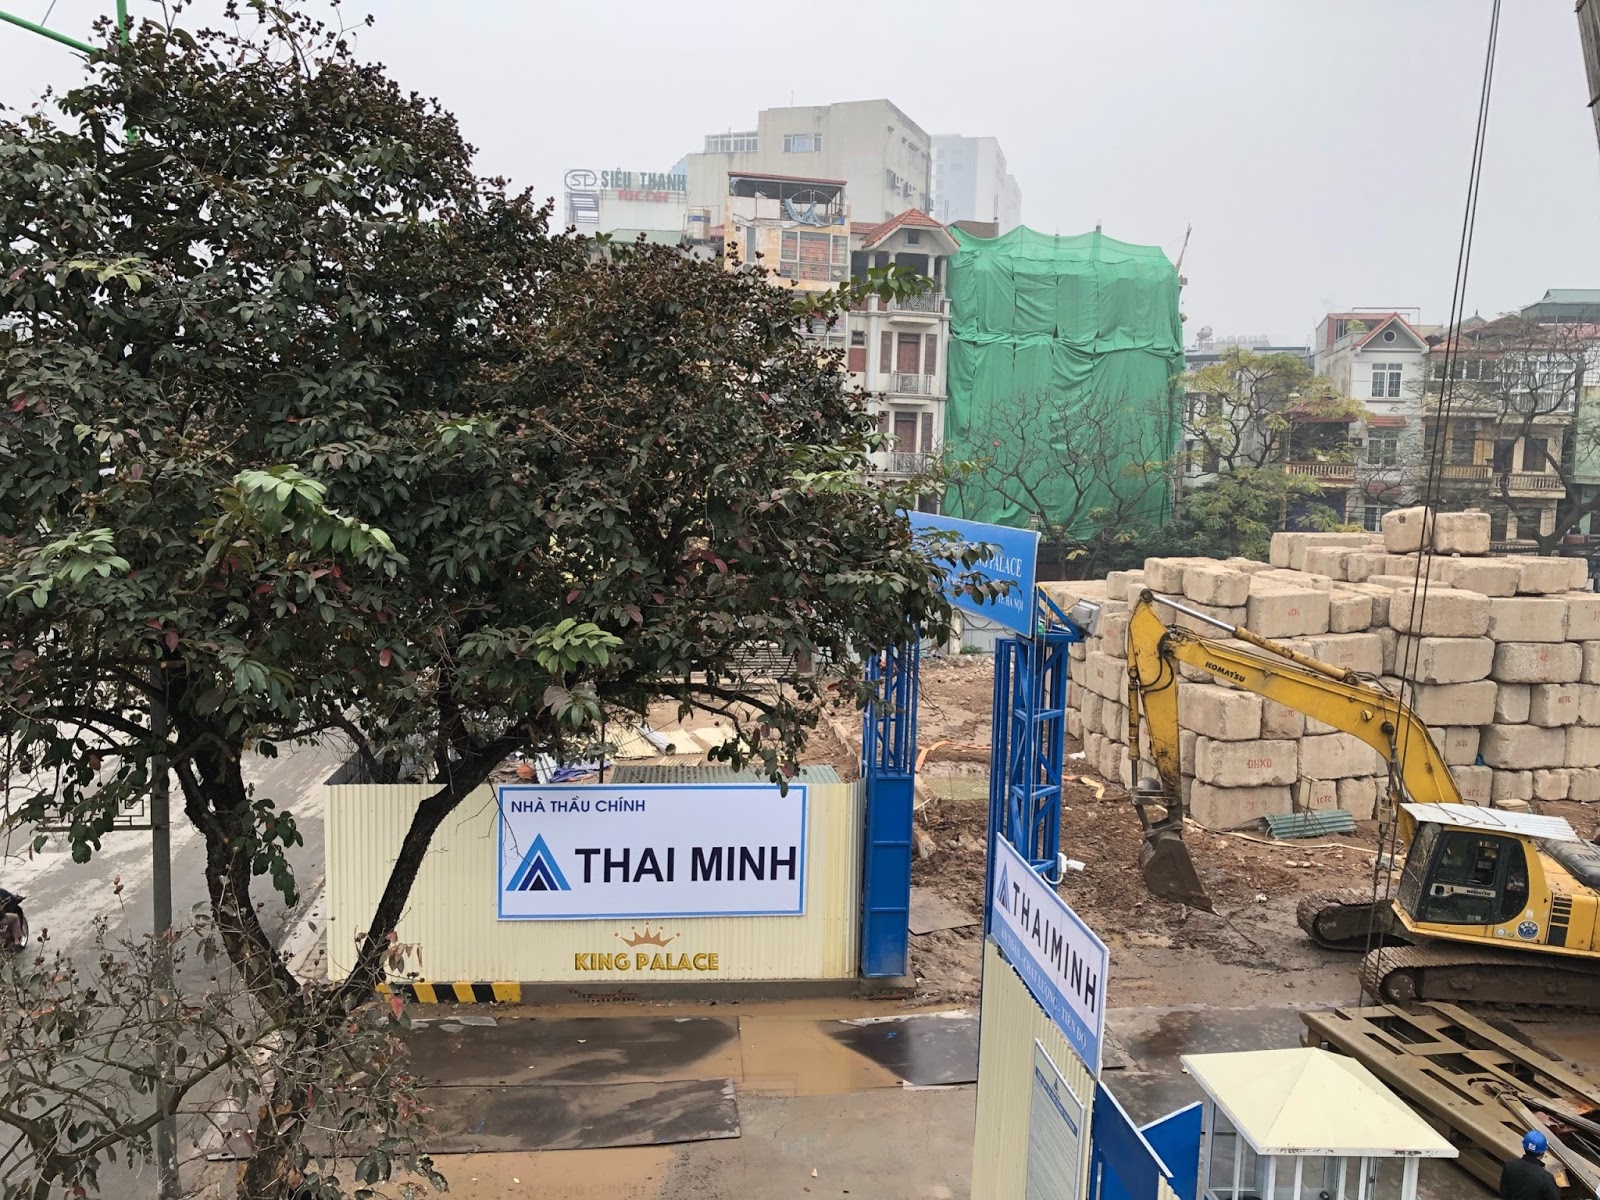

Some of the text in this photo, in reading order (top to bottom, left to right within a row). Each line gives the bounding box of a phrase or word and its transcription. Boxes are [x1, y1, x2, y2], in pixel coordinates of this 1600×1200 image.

[601, 167, 632, 188] SIÊU
[640, 172, 686, 191] THANH
[989, 553, 1023, 578] PALACE
[1205, 661, 1246, 683] KOMATSU
[511, 796, 646, 813] NHÀ THẦU CHÍNH
[574, 846, 797, 884] THAI MINH
[574, 952, 720, 971] KING PALACE
